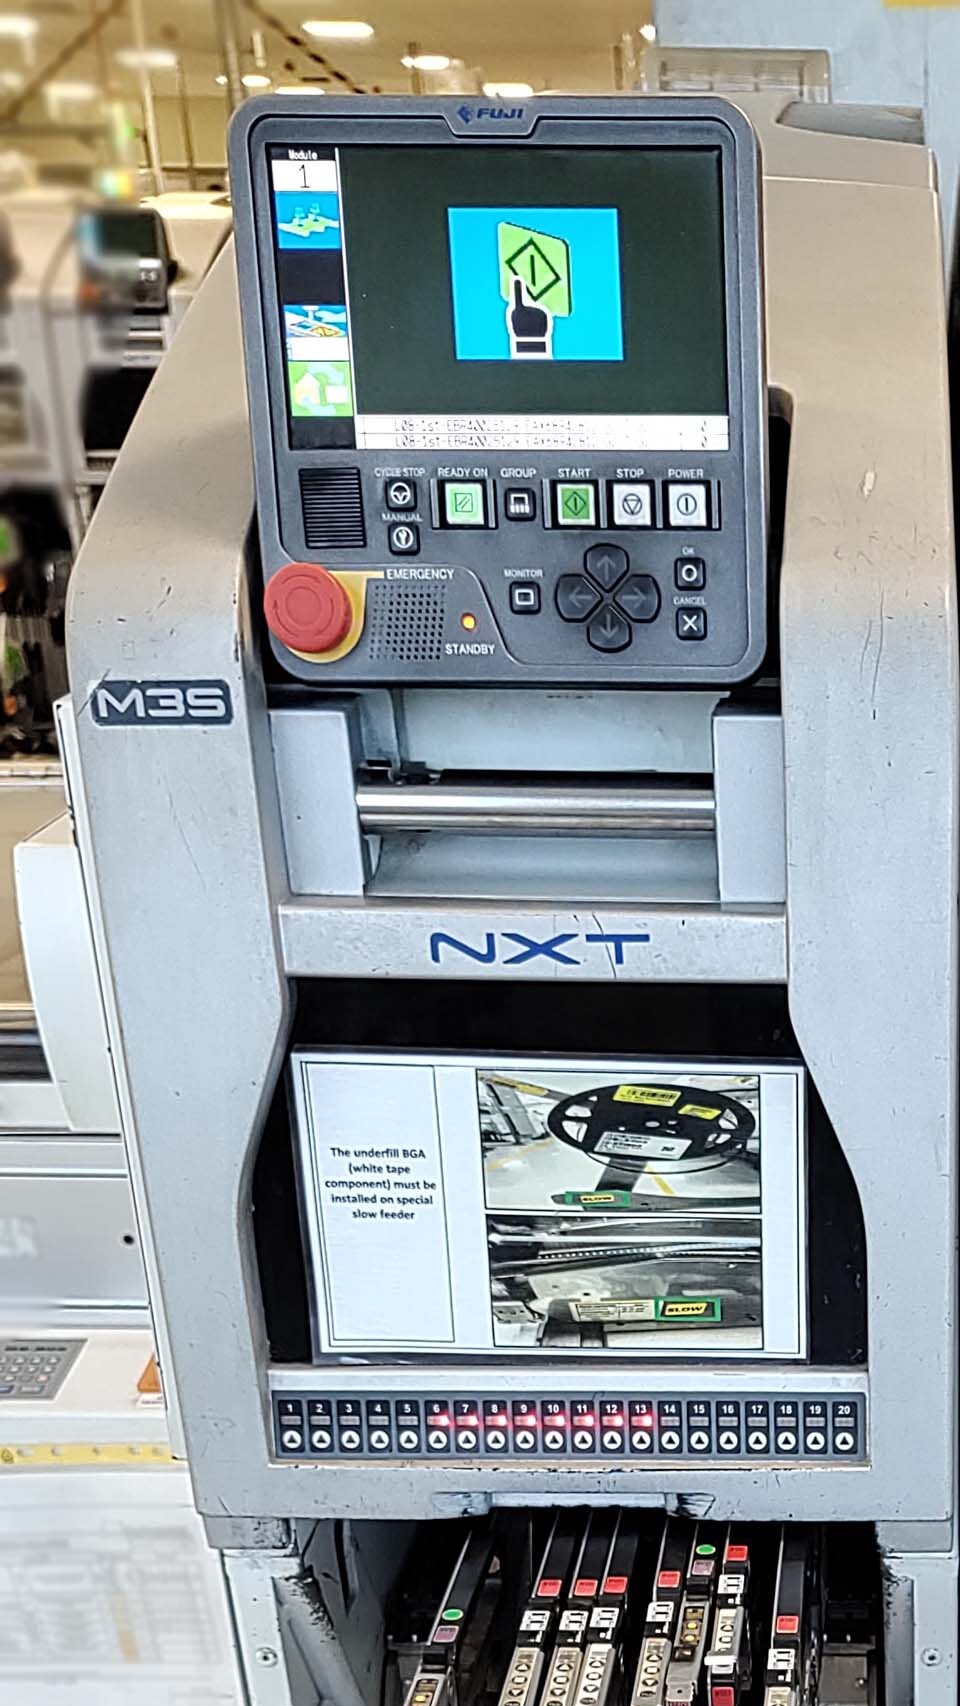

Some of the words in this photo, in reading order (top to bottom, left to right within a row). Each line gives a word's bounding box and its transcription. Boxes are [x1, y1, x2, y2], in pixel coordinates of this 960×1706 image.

[476, 107, 524, 120] FUJI
[288, 149, 318, 160] Module
[299, 164, 311, 189] 1
[374, 467, 401, 477] CYCLE
[402, 467, 426, 477] STOP
[437, 467, 470, 477] READY
[473, 467, 488, 477] ON
[500, 468, 537, 478] GROUP
[557, 468, 591, 478] START
[616, 468, 644, 478] STOP
[668, 468, 704, 479] POWER
[382, 512, 423, 522] MANUAL
[682, 546, 695, 556] OK
[386, 568, 455, 580] EMERGENCY
[504, 568, 544, 578] MONITOR
[673, 596, 707, 606] CANCEL
[445, 643, 496, 655] STANDBY
[98, 686, 226, 719] M3S
[430, 932, 651, 966] NXT
[330, 1147, 351, 1158] The
[354, 1148, 400, 1159] underfill
[402, 1149, 426, 1159] BGA
[348, 1162, 383, 1175] (white
[386, 1164, 411, 1176] tape
[325, 1178, 391, 1191] component)
[393, 1181, 421, 1190] must
[423, 1180, 437, 1190] be
[331, 1193, 378, 1204] installed
[380, 1196, 394, 1205] on
[396, 1194, 433, 1206] special
[352, 1209, 377, 1219] slow
[380, 1209, 416, 1220] feeder
[548, 1404, 560, 1413] 10
[576, 1404, 588, 1413] 11
[605, 1404, 618, 1414] 12
[634, 1404, 647, 1414] 13
[663, 1404, 676, 1414] 14
[693, 1404, 705, 1414] 15
[722, 1405, 734, 1414] 16
[751, 1405, 763, 1414] 17
[780, 1405, 792, 1414] 18
[809, 1405, 822, 1414] 19
[838, 1405, 851, 1414] 20
